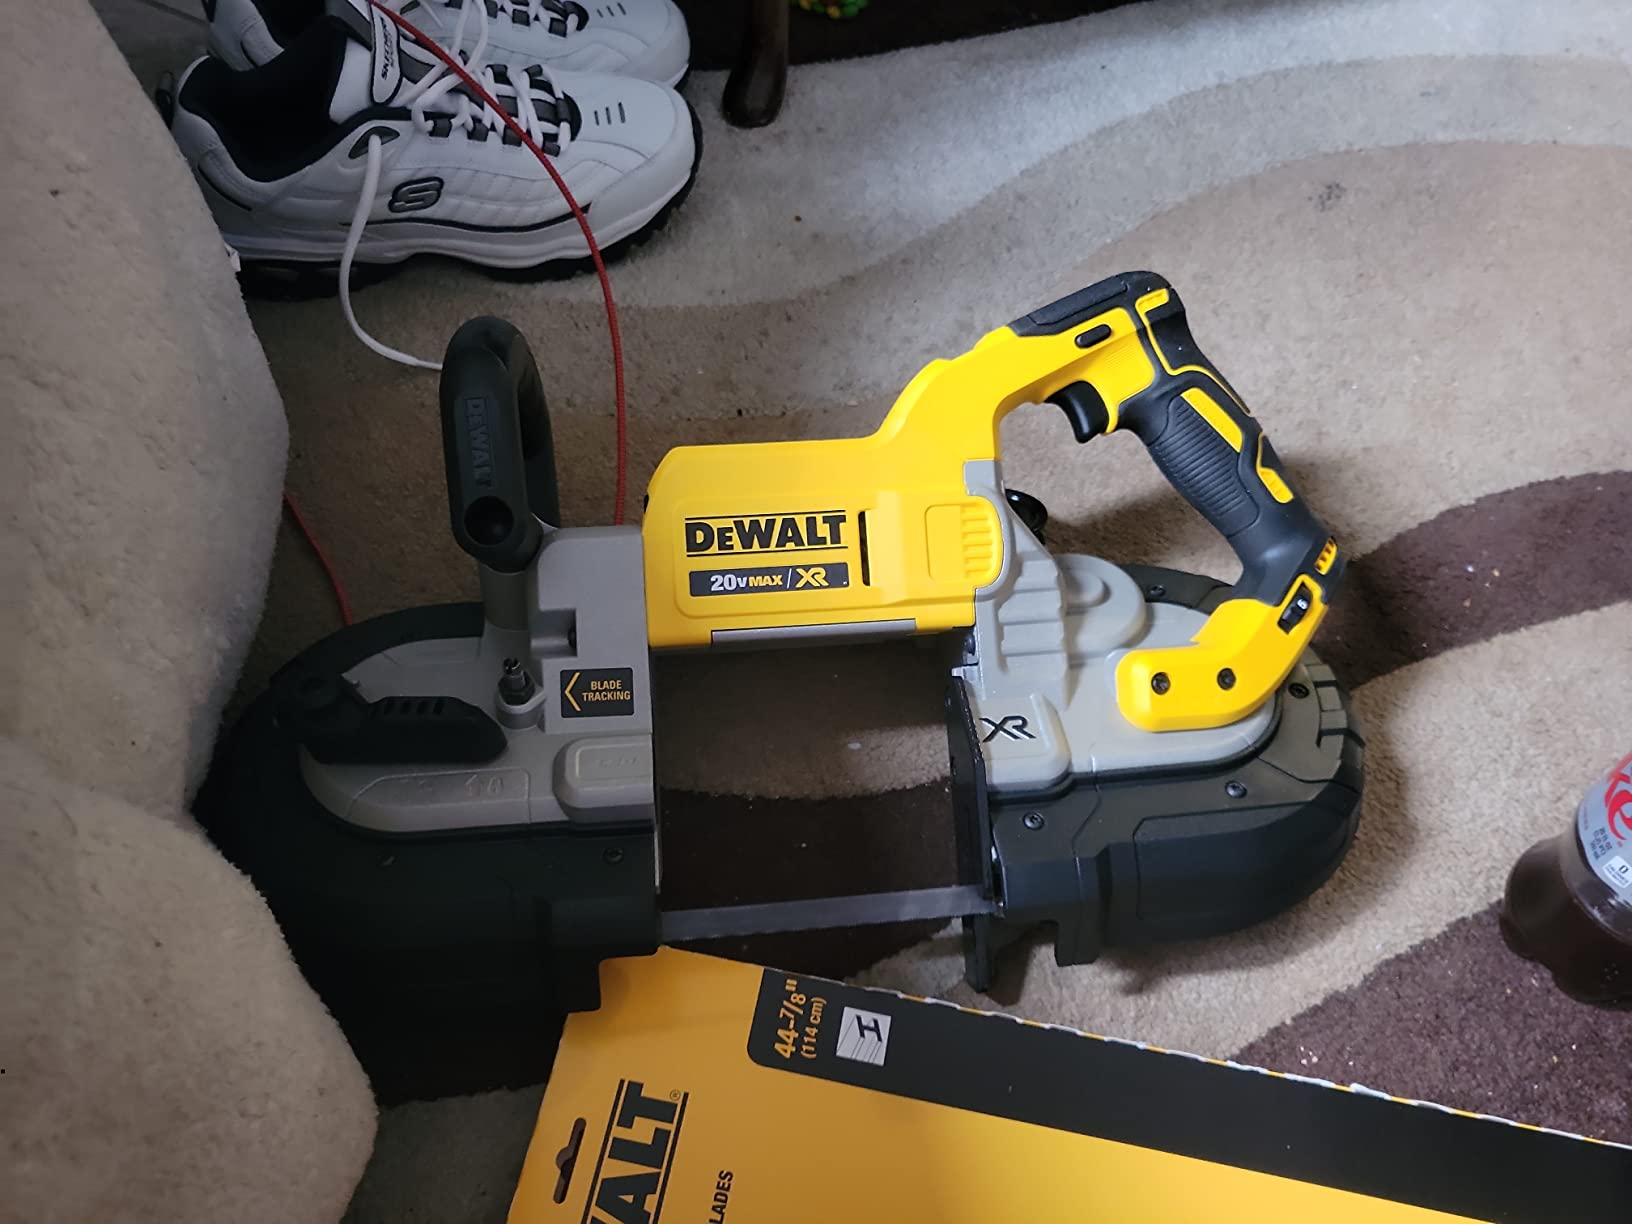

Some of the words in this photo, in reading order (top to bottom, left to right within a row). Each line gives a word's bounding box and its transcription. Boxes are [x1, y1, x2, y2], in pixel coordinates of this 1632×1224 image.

[685, 514, 847, 553] DEWALT
[795, 567, 829, 588] XR
[582, 690, 631, 702] TRACKING
[590, 680, 622, 691] BLADE
[979, 716, 1037, 743] XR
[774, 979, 806, 1059] 44-7/8"
[800, 1026, 818, 1059] (114
[810, 997, 827, 1024] cm)
[589, 1080, 678, 1224] ALT
[709, 1169, 734, 1224] LADES
